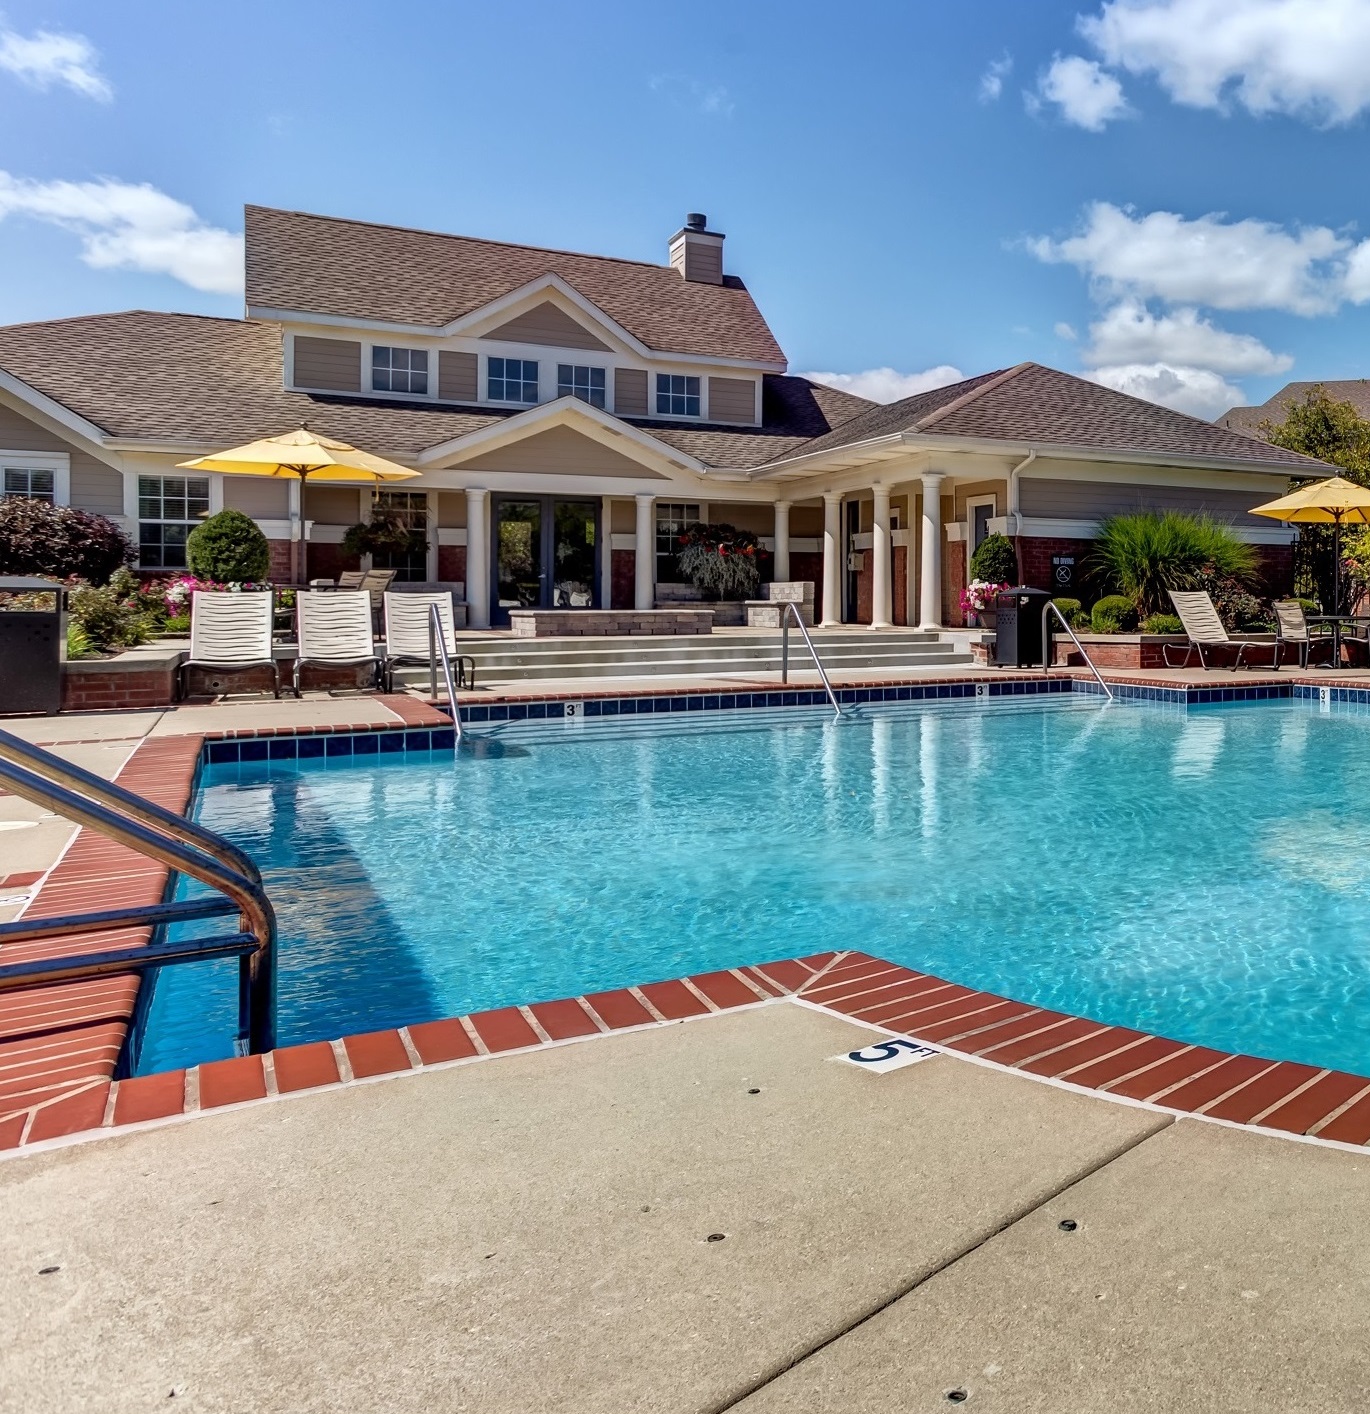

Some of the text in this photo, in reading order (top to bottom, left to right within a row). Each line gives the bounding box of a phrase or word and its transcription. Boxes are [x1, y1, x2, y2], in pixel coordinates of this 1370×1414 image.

[977, 685, 983, 695] 3
[1320, 689, 1325, 699] 3
[566, 704, 575, 716] 3
[848, 1039, 941, 1062] 5 FT
